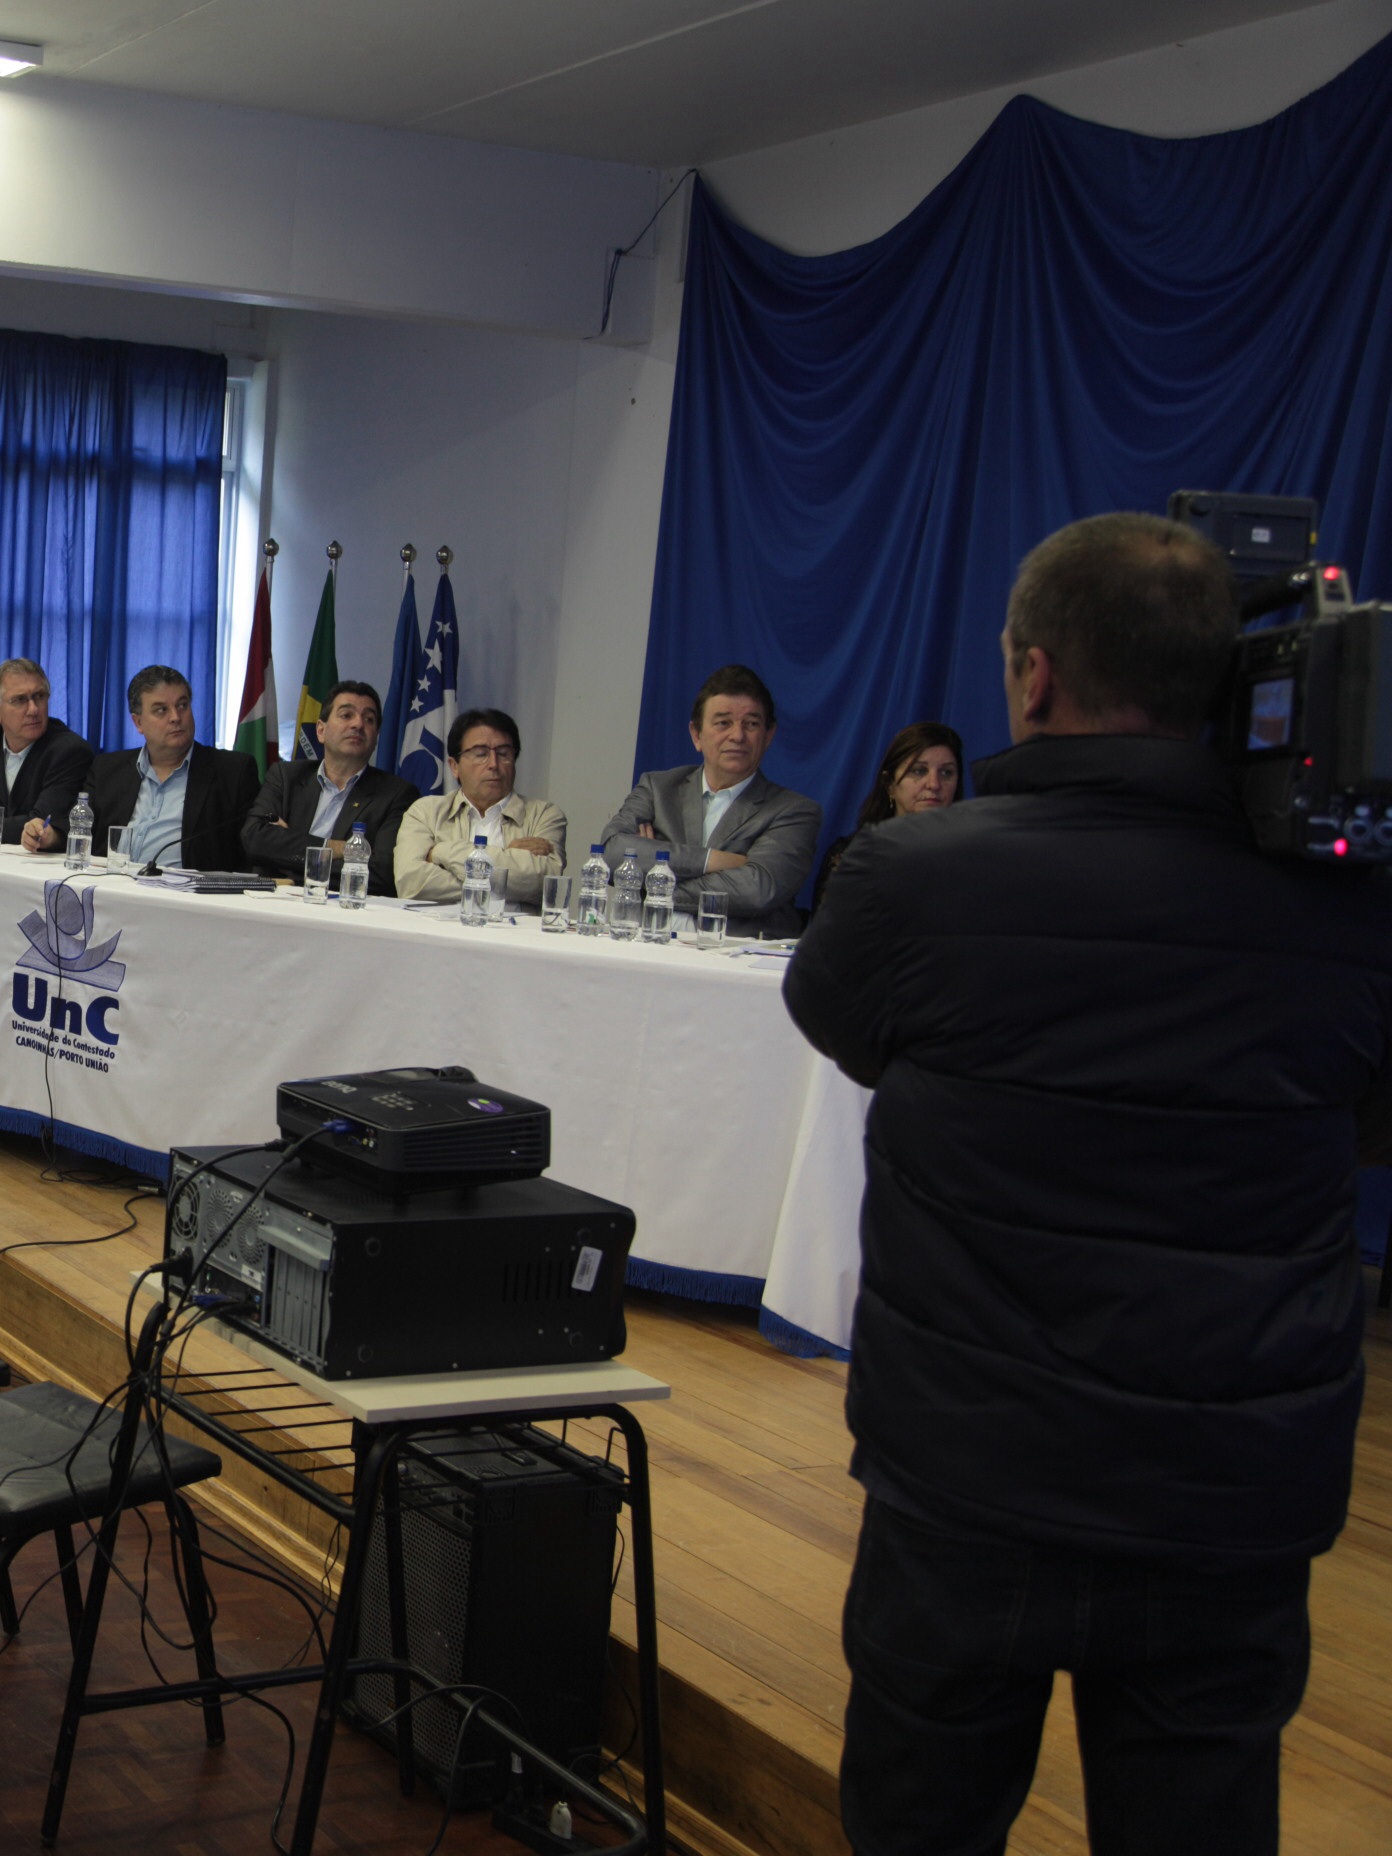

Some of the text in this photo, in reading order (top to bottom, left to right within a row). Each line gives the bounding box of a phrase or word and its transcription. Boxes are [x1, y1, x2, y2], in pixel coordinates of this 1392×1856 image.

[299, 731, 314, 757] RDEM
[12, 972, 120, 1046] UnC
[12, 1020, 115, 1059] Universidade do Contestado
[85, 1057, 109, 1073] UNIÃO
